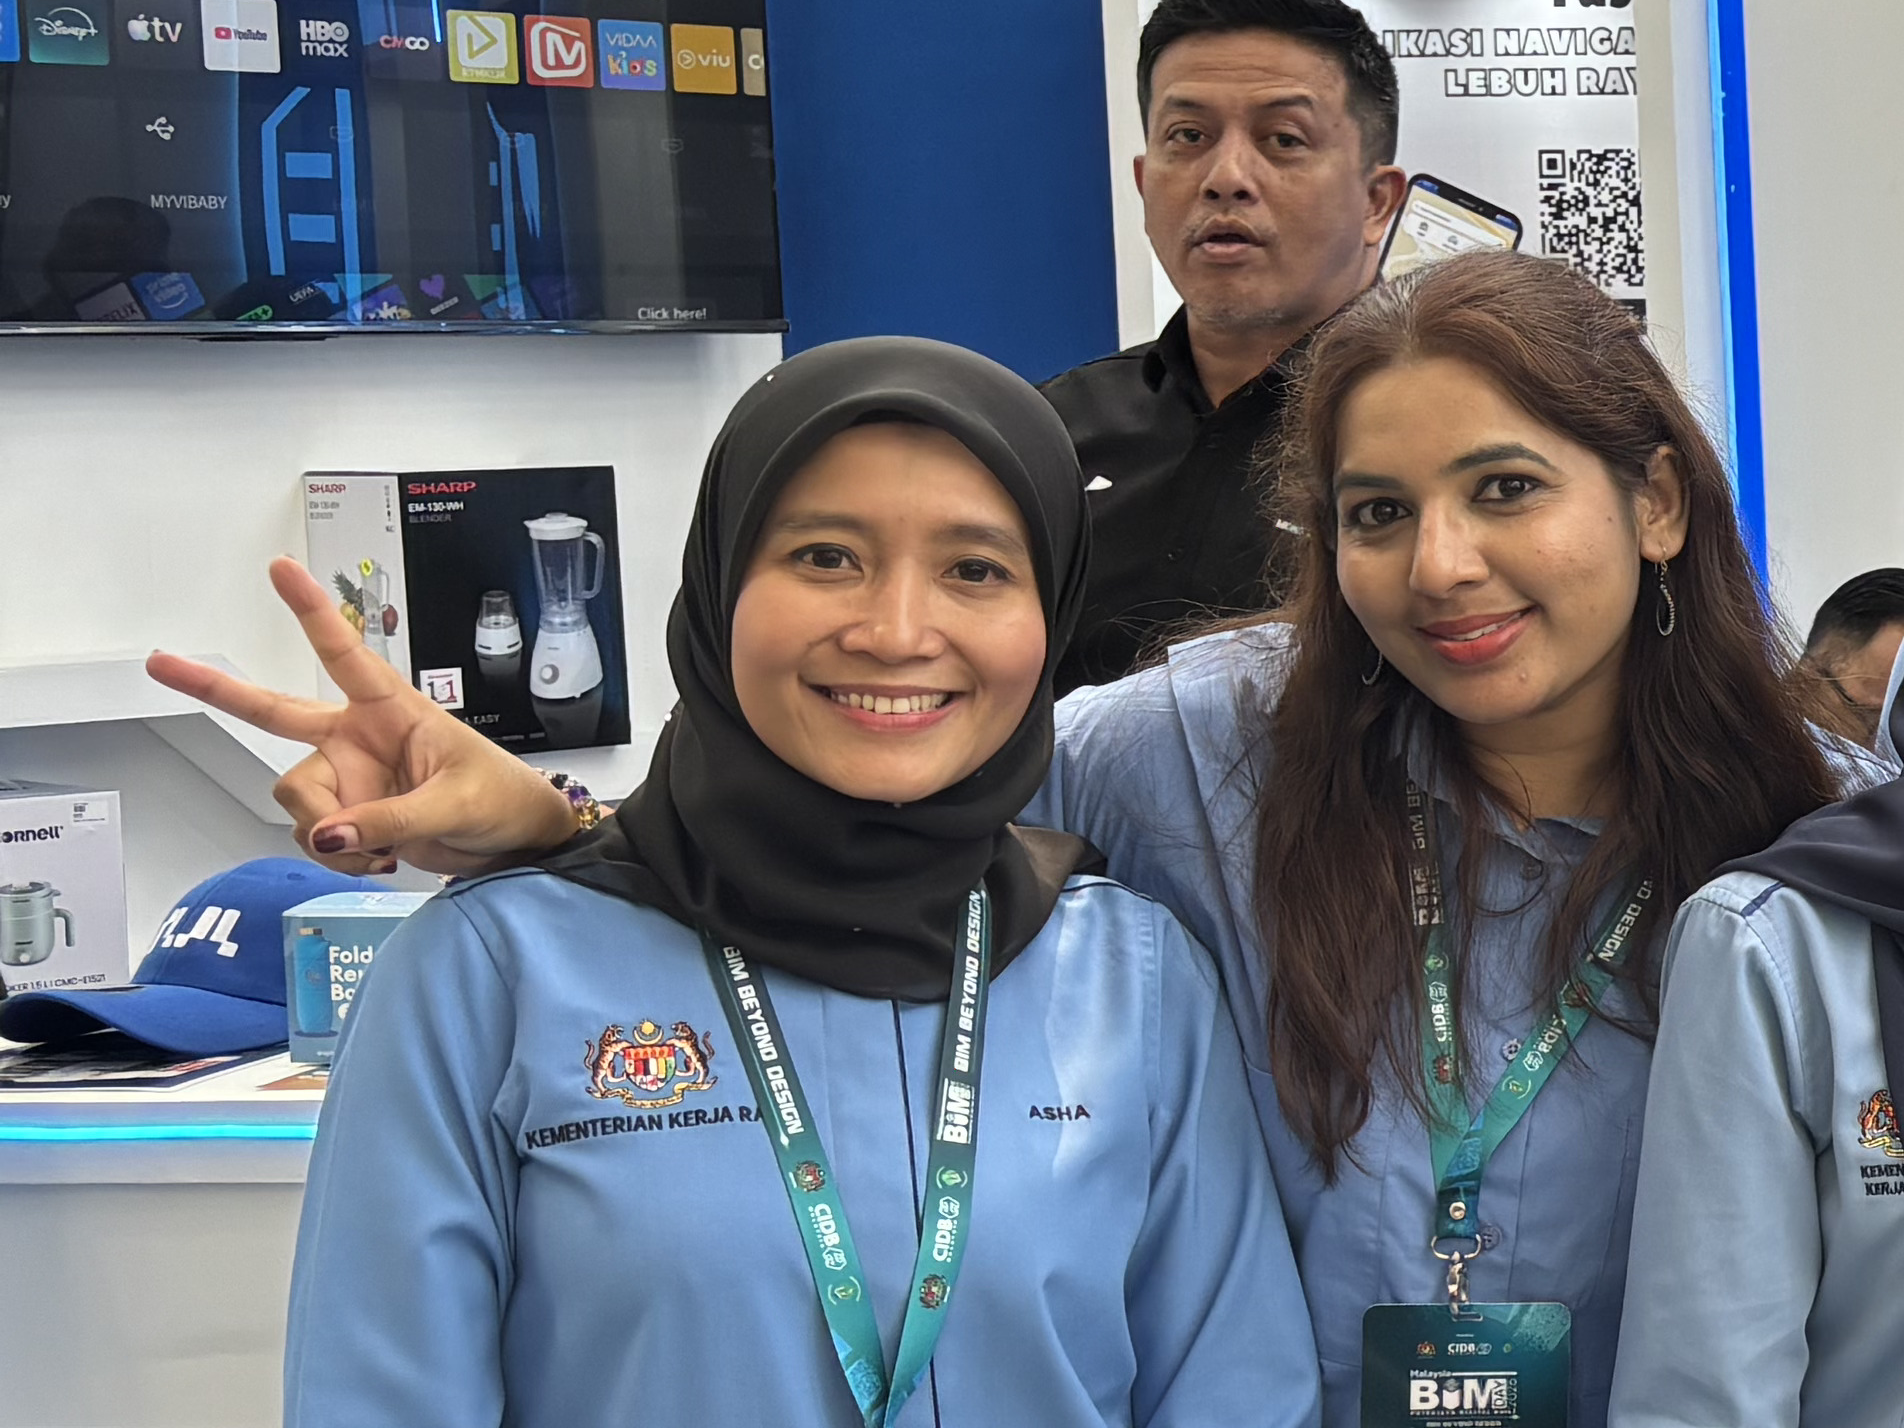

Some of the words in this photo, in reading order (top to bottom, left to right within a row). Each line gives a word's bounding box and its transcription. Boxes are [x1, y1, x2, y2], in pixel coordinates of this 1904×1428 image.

[151, 17, 182, 42] tv
[300, 19, 349, 41] HBO
[301, 43, 348, 57] max
[698, 49, 731, 67] viu
[1445, 67, 1566, 97] LEBUH
[150, 194, 227, 209] MYVIBABY
[637, 307, 671, 320] Click
[673, 307, 706, 321] here!
[308, 483, 346, 494] SHARP
[408, 481, 477, 494] SHARP
[966, 889, 982, 953] DESIGN
[959, 956, 979, 1032] BEYOND
[722, 945, 750, 983] BIM
[737, 983, 779, 1062] BEYOND
[766, 1065, 804, 1135] DESIGN
[954, 1040, 973, 1073] BIM
[1029, 1104, 1091, 1121] ASHA
[525, 1113, 663, 1150] KEMENTERIAN
[668, 1106, 734, 1130] KERJA
[814, 1202, 840, 1246] CIDB
[932, 1218, 953, 1262] CIDB
